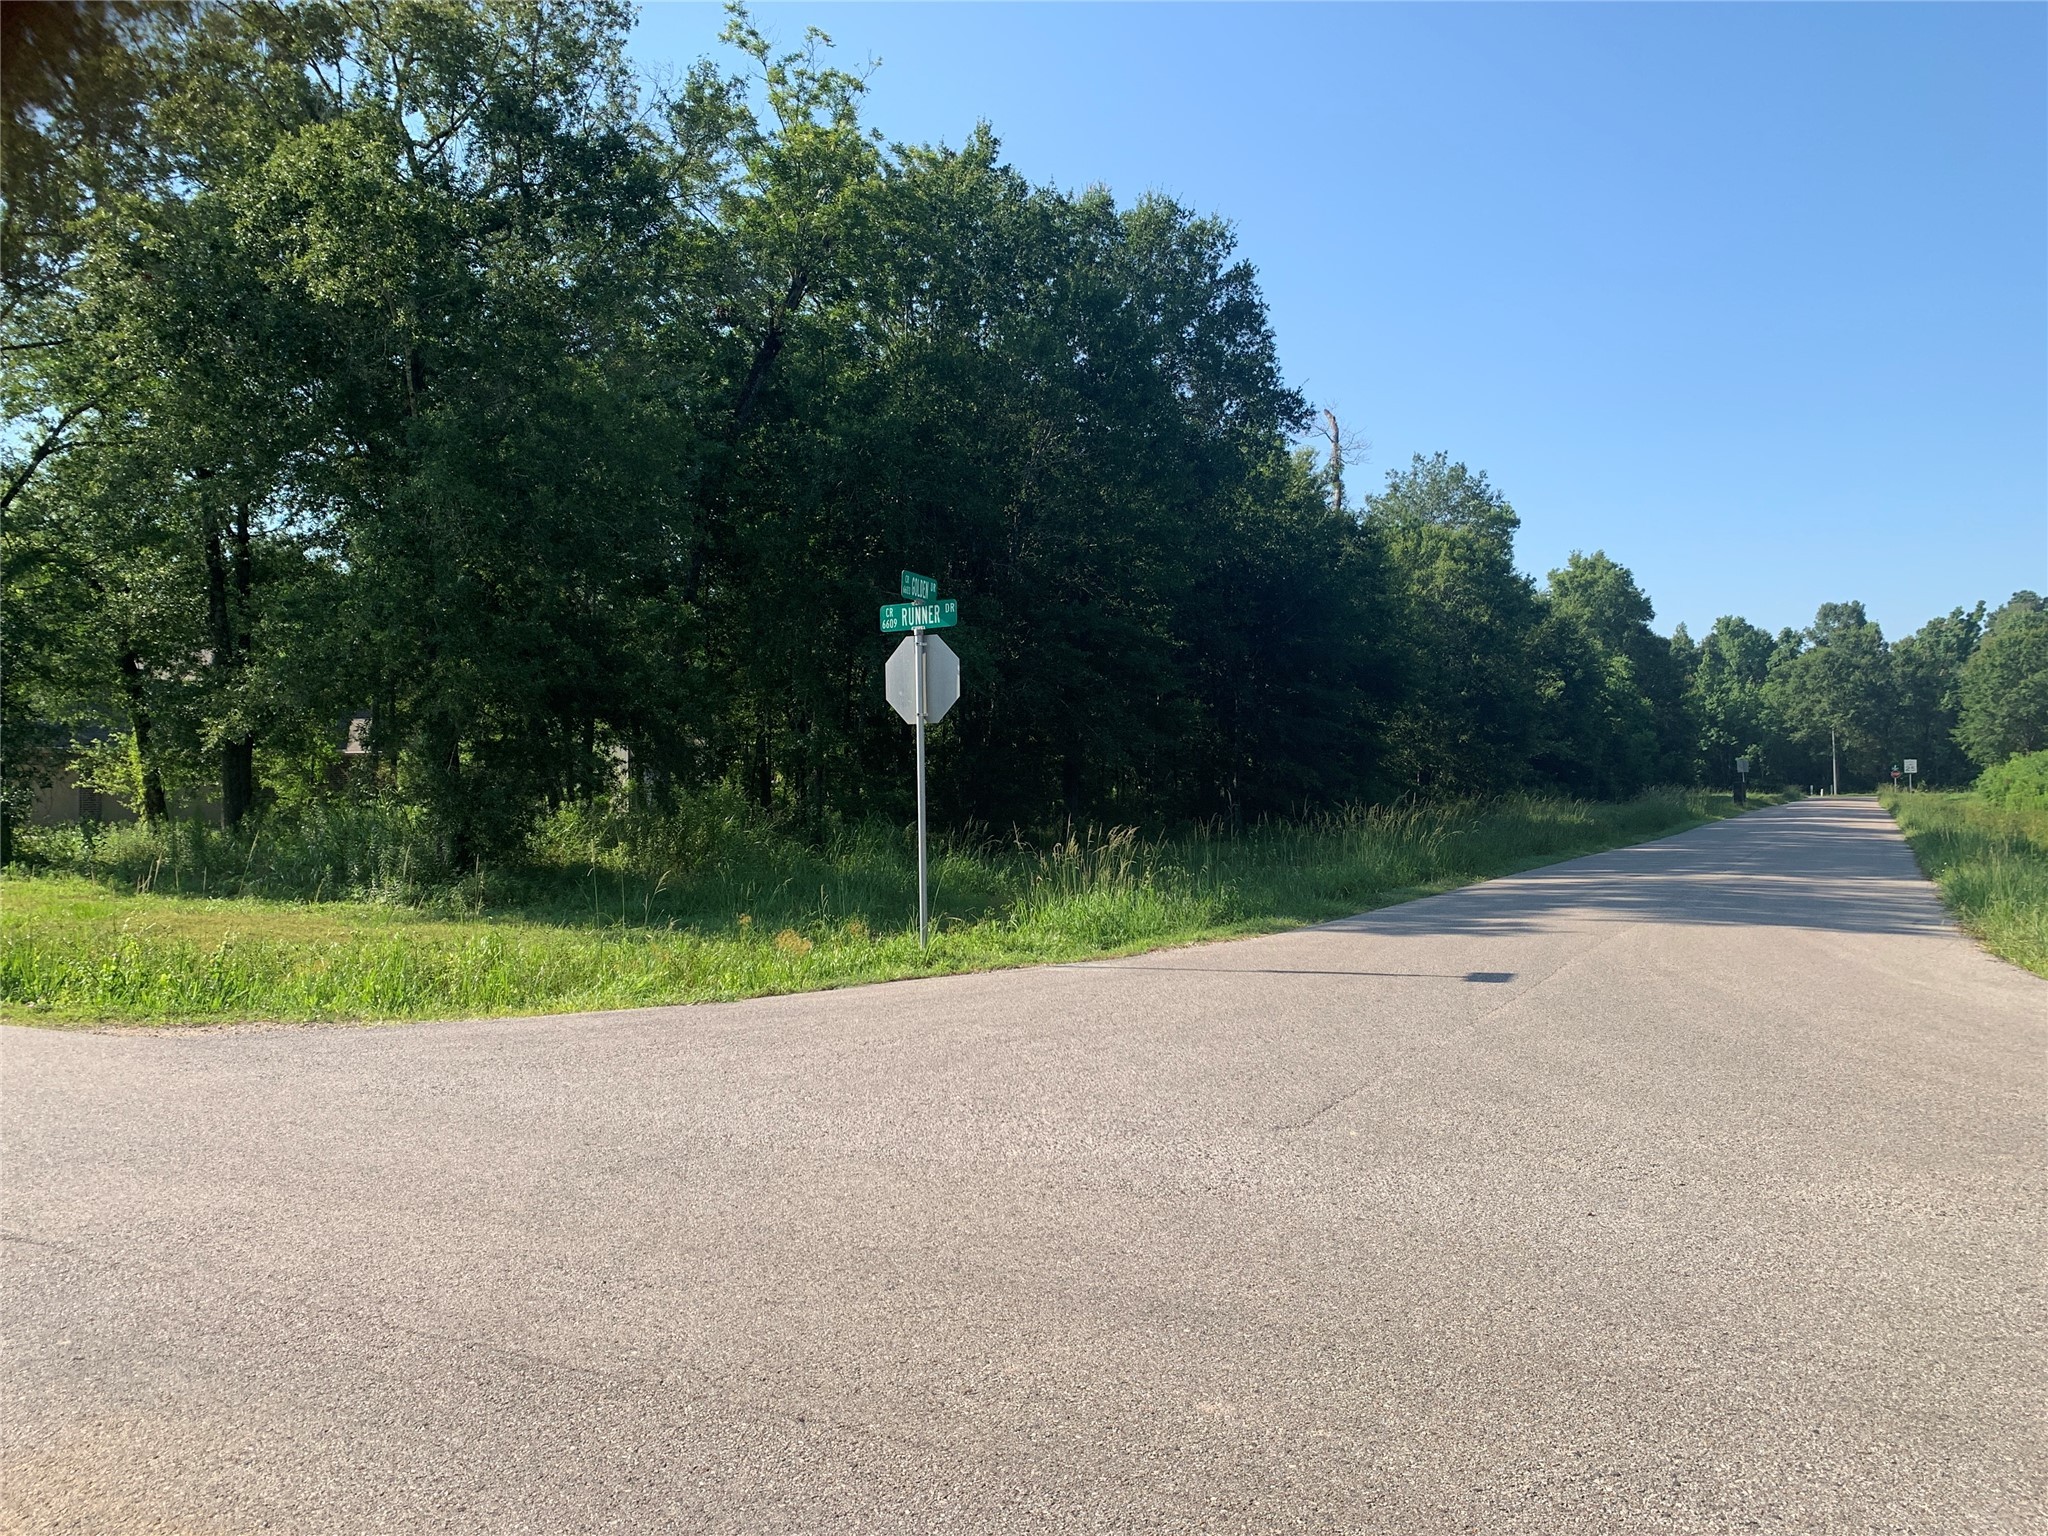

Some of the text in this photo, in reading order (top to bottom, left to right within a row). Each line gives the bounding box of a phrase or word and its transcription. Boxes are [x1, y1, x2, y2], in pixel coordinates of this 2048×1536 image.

[911, 577, 936, 599] GOLDEN DR
[885, 608, 893, 617] CR
[901, 603, 955, 626] RUNNER DR
[882, 618, 897, 629] 6609
